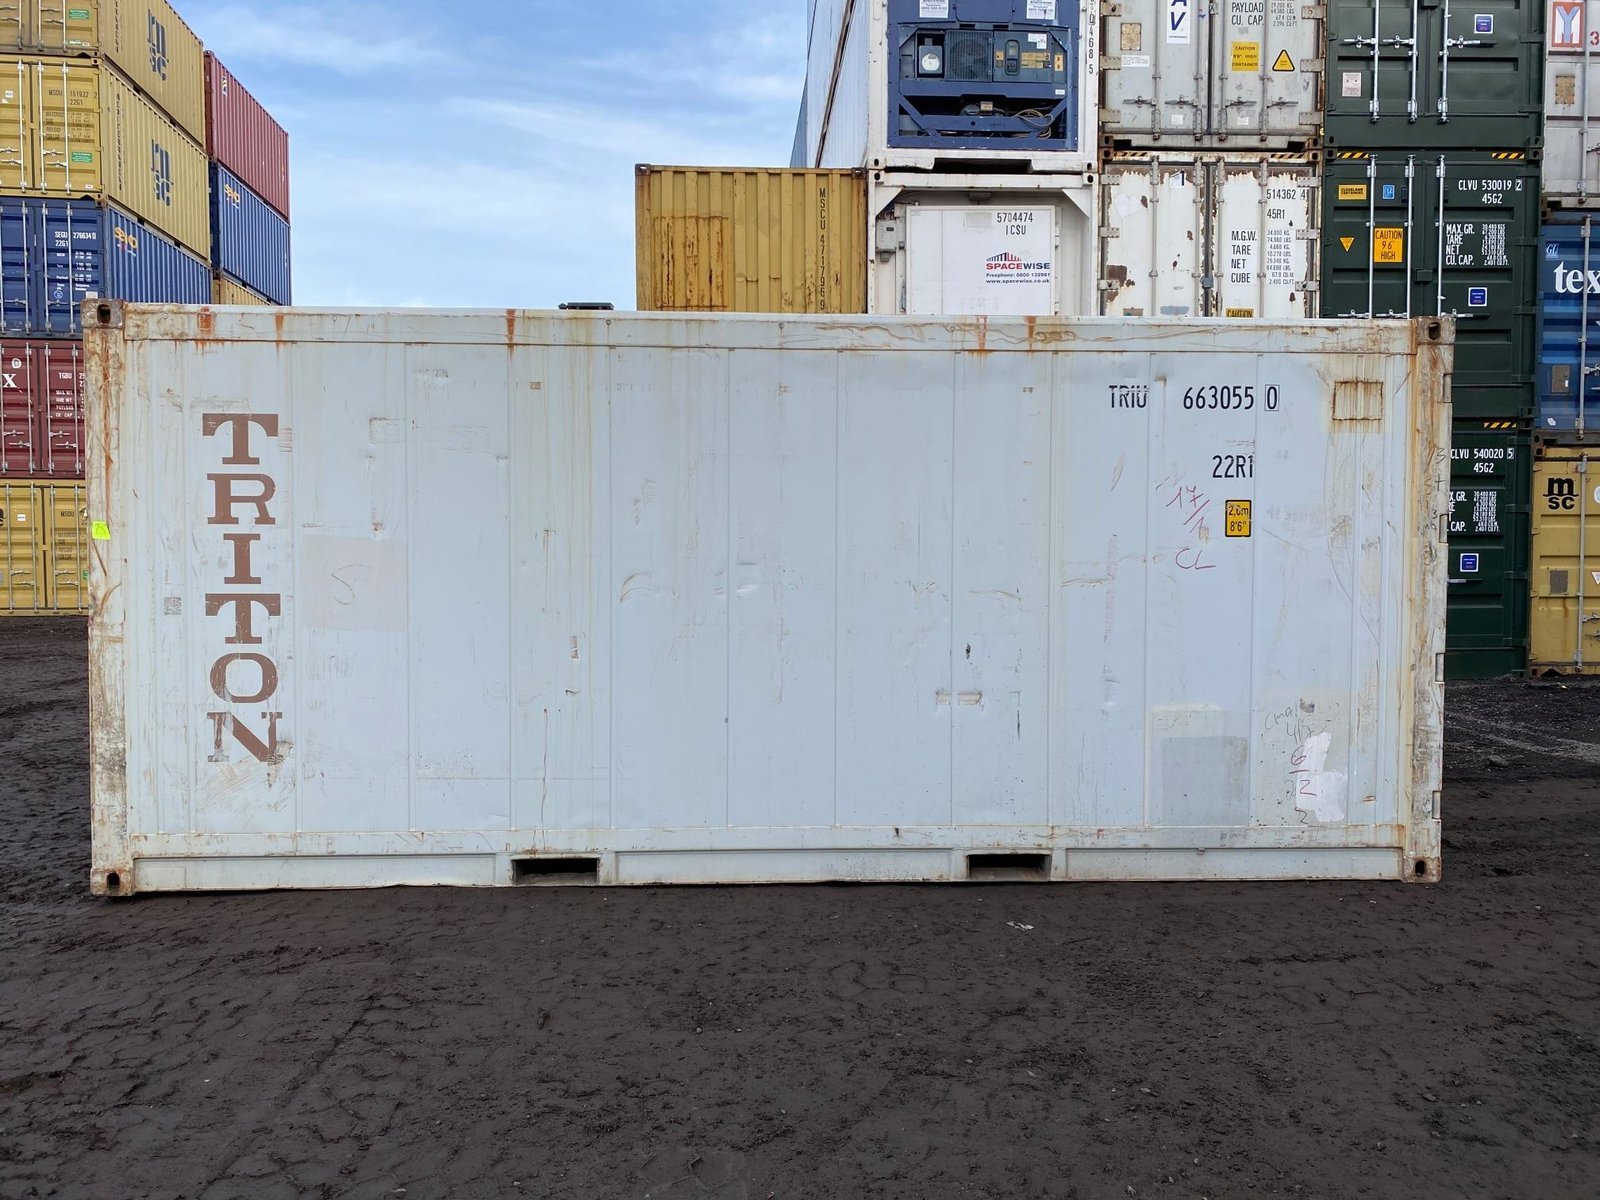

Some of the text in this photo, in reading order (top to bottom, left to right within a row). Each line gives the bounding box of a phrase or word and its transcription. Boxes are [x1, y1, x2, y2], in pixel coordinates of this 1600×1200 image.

[1232, 2, 1264, 12] PAYLOAD
[1458, 179, 1522, 191] CLVU 530019 2
[1266, 189, 1306, 200] 514362 4
[1482, 193, 1503, 204] 45G2
[997, 212, 1033, 222] 5704474
[1267, 209, 1285, 219] 45R1
[1231, 231, 1257, 241] M.G.W.
[1376, 231, 1402, 239] CAUTION
[1447, 235, 1463, 244] TARE
[1232, 245, 1251, 255] TARE
[1446, 245, 1460, 255] NET
[1381, 251, 1395, 260] HIGH
[1446, 255, 1457, 265] CU.
[1459, 255, 1474, 265] CAP.
[1231, 259, 1246, 269] NET
[1231, 273, 1250, 283] CUBE
[1109, 385, 1278, 410] TRIU 663055 0
[1450, 448, 1514, 459] CLVU 540020 5
[1212, 455, 1254, 478] 22R1
[1473, 463, 1494, 473] 45G2
[202, 413, 282, 762] TRITON
